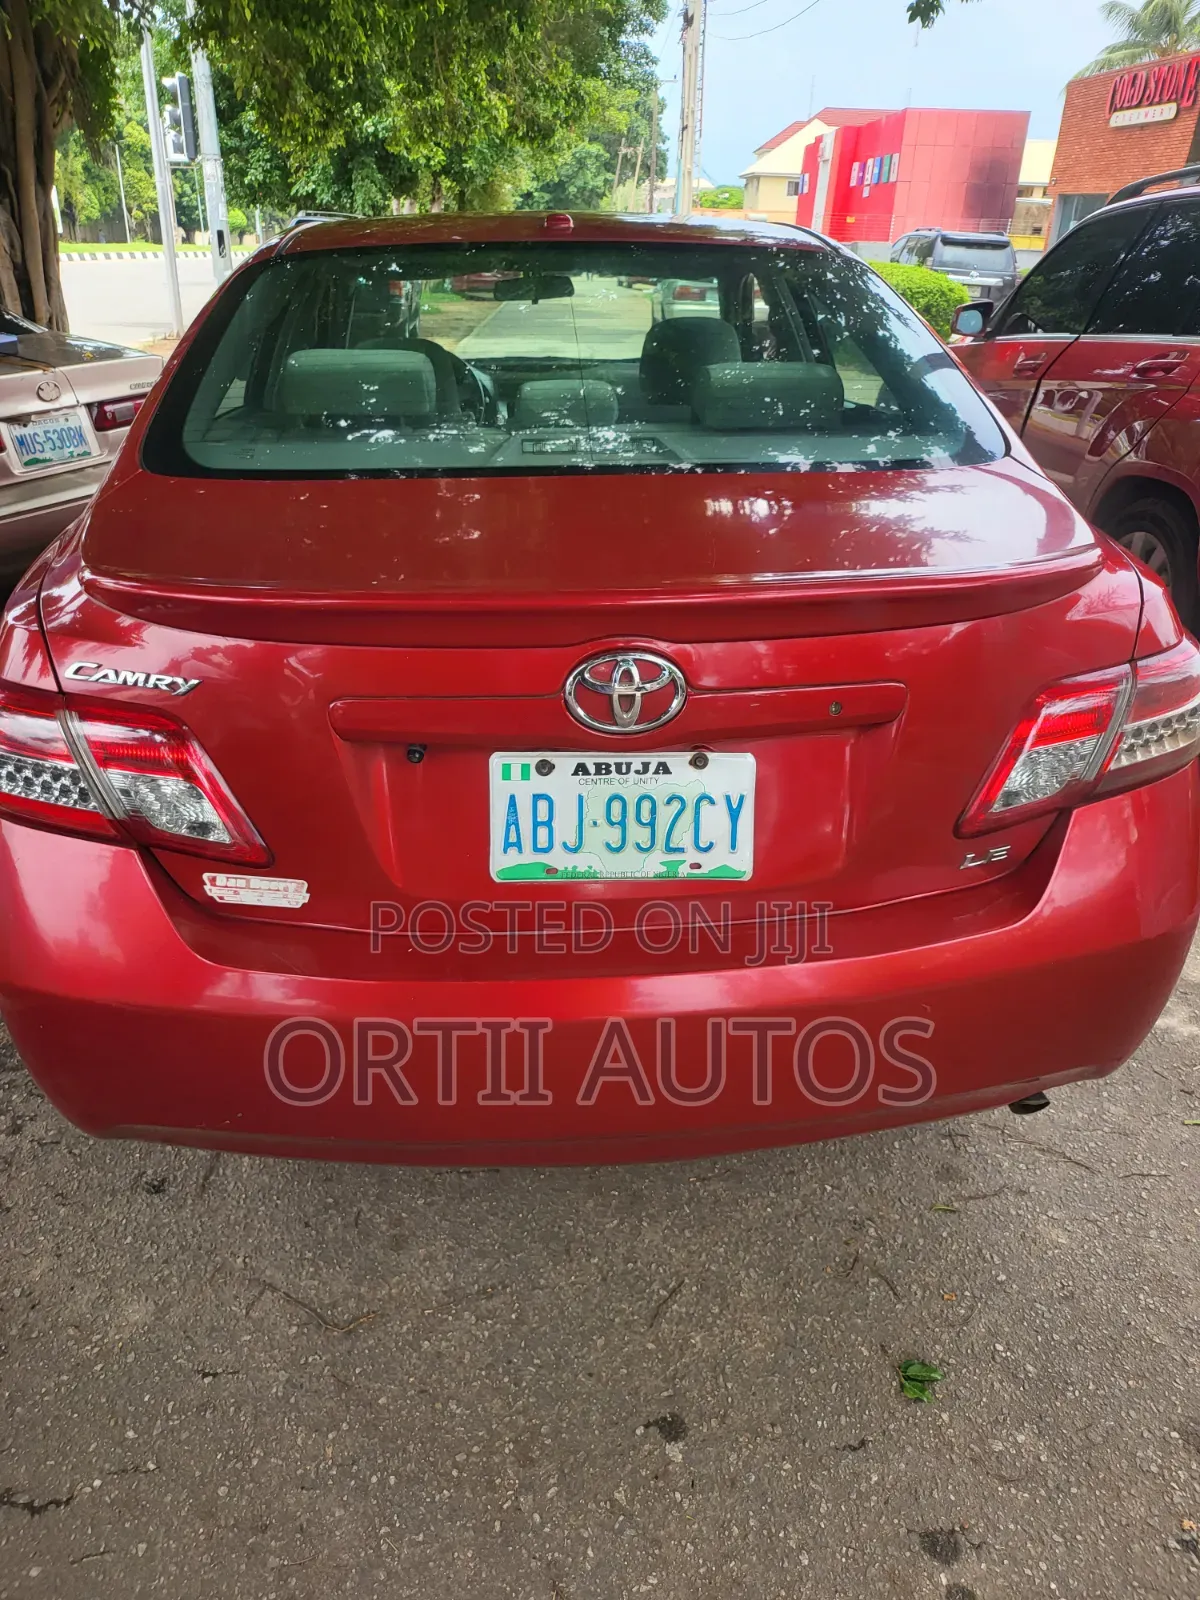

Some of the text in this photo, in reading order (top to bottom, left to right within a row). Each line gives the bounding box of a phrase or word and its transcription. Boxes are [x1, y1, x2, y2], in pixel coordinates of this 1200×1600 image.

[1105, 56, 1200, 119] COLD STONE
[64, 661, 202, 696] CAMRY
[571, 761, 673, 777] ABUJA
[578, 776, 660, 786] CENTRE OF UNITY
[502, 793, 746, 854] ABJ-992CY
[960, 845, 1011, 870] LE
[641, 869, 651, 878] OF
